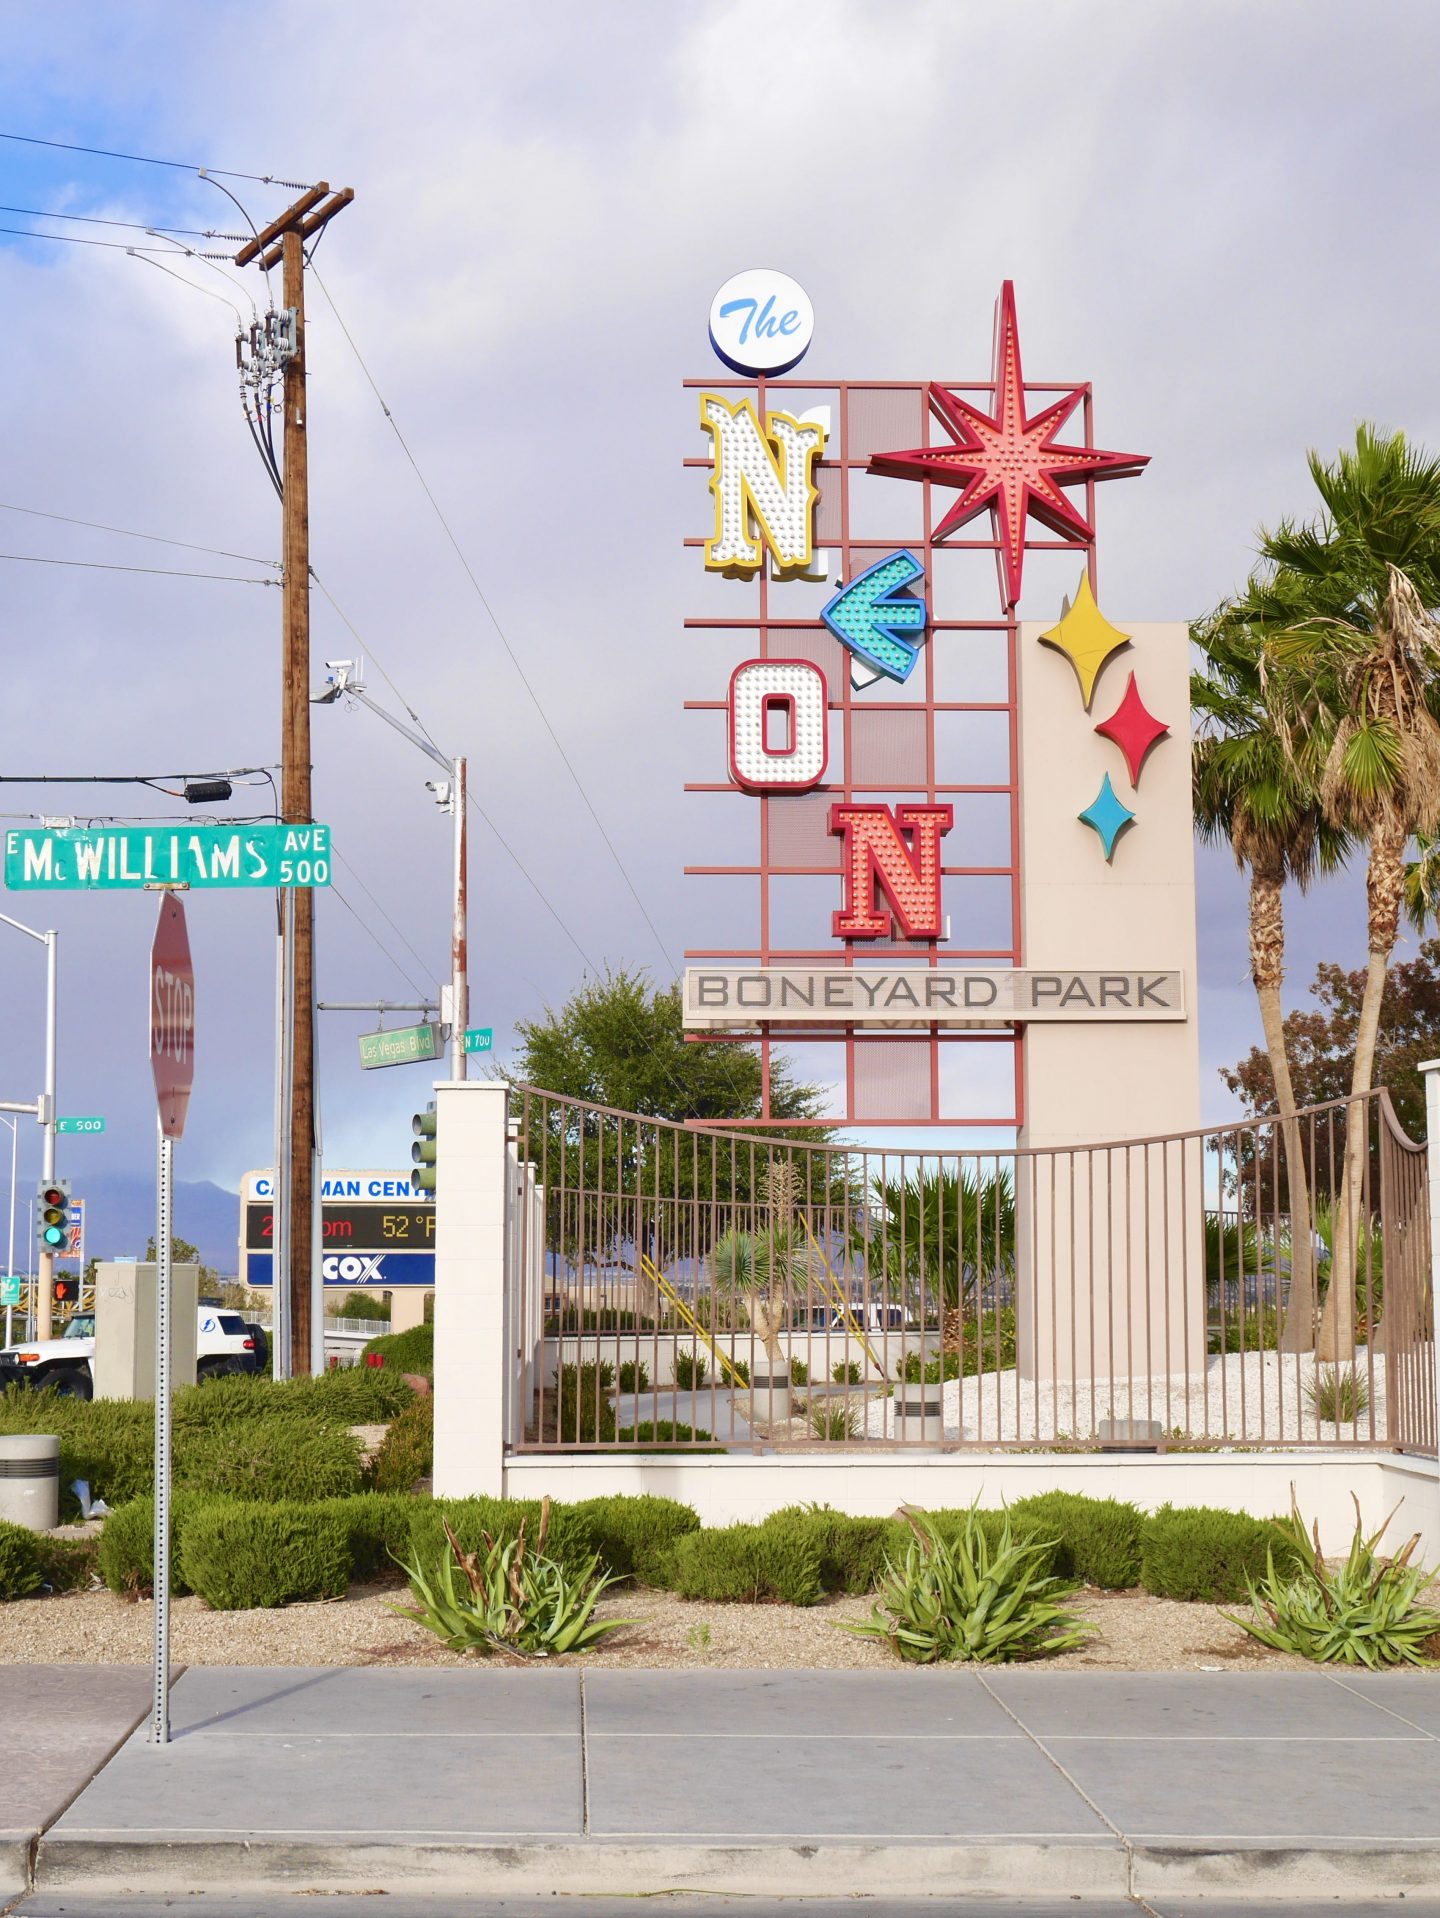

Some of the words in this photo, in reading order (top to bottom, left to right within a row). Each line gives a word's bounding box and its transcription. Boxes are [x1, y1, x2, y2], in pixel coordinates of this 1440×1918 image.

[719, 294, 802, 345] The
[7, 832, 19, 854] E
[284, 828, 326, 851] AVE
[280, 859, 328, 883] 500
[698, 976, 998, 1007] BONEYARD
[1031, 976, 1171, 1007] PARK
[154, 964, 192, 1065] STOP
[361, 1044, 377, 1060] Las
[379, 1040, 406, 1059] Vegas
[409, 1034, 431, 1052] Blvd
[465, 1036, 471, 1048] N
[475, 1033, 490, 1047] 700
[60, 1121, 67, 1131] E
[76, 1120, 102, 1131] 500
[383, 1215, 409, 1238] 52
[322, 1254, 386, 1284] COX
